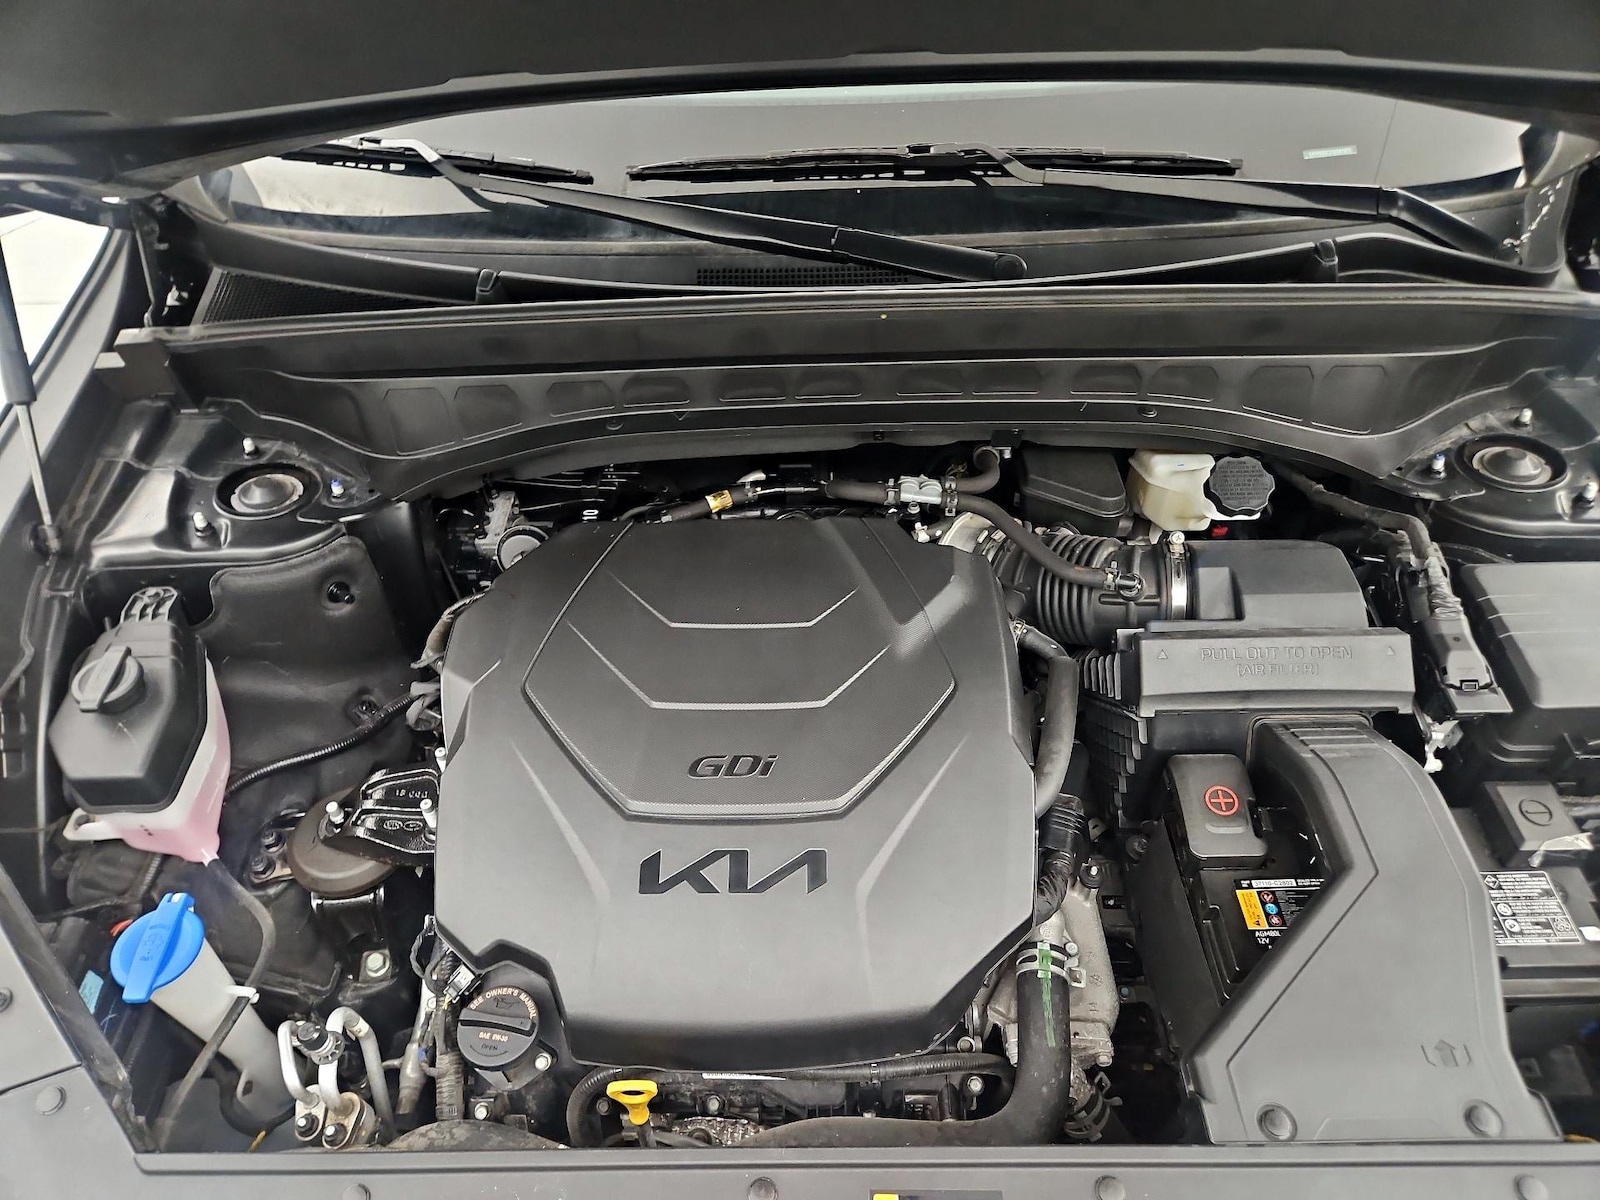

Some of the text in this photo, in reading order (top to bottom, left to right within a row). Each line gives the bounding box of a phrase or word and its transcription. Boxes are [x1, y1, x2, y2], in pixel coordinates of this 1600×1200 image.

[1201, 645, 1353, 661] PULL OUT TO OPEN
[688, 754, 779, 779] GDi
[638, 848, 828, 894] KIA
[470, 987, 538, 1019] SEE OWNER'S MANUAL
